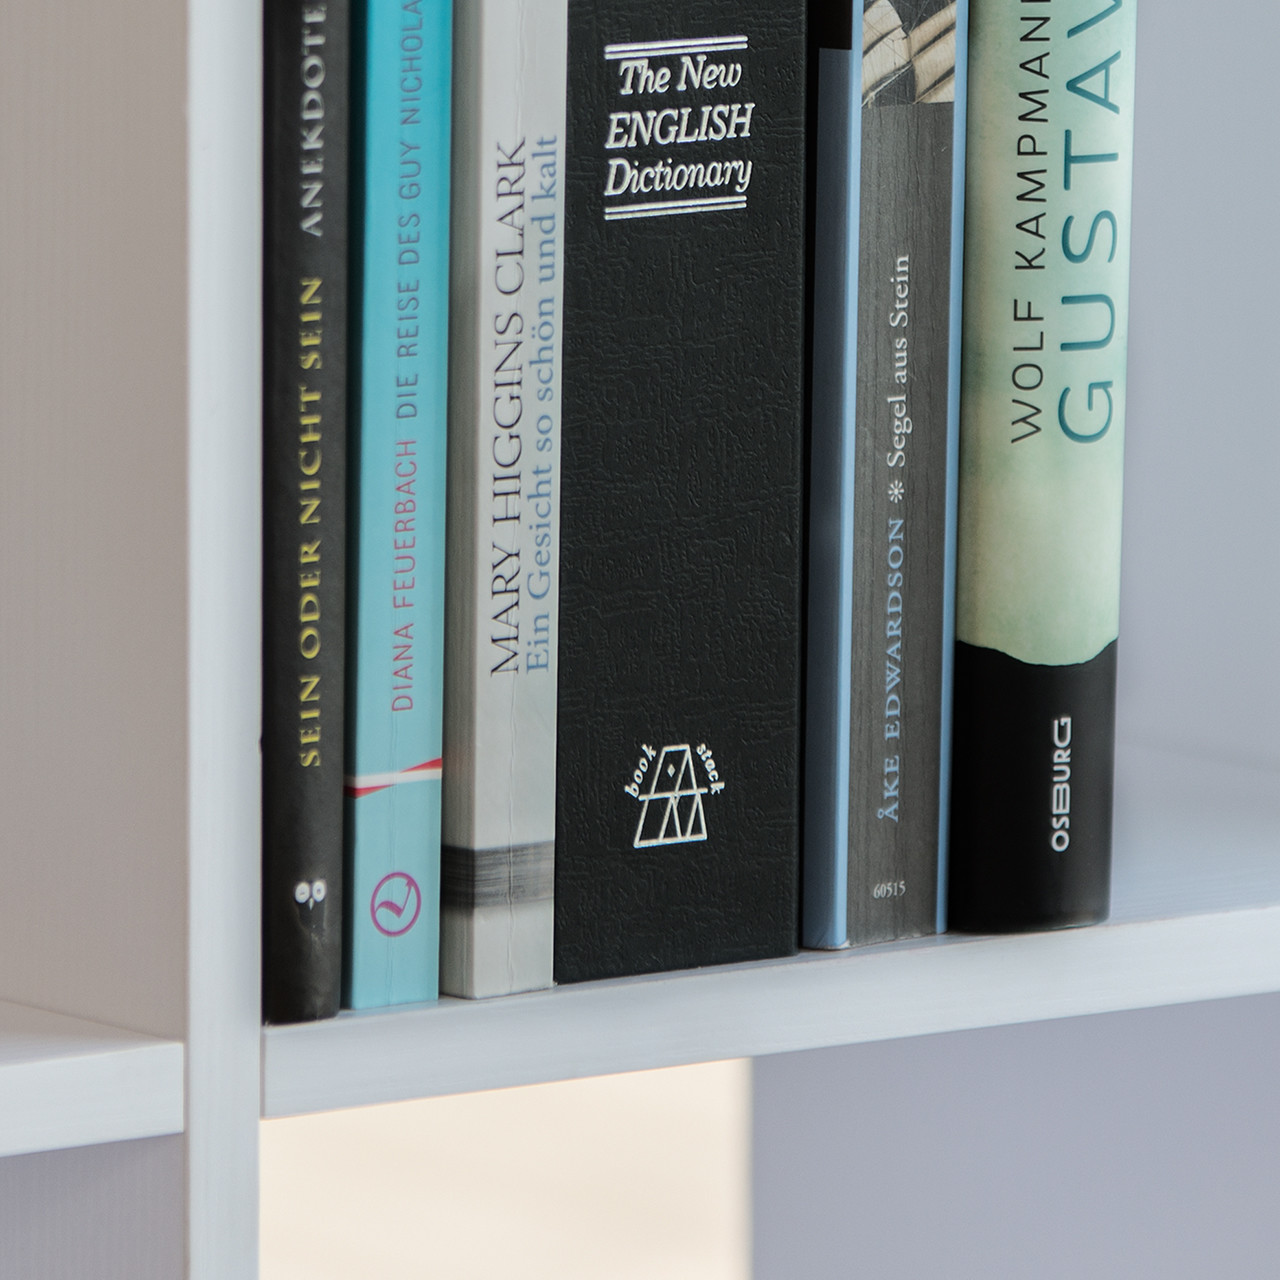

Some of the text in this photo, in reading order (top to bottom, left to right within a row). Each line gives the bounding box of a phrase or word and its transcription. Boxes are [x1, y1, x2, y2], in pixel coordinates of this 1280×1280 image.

[620, 53, 742, 95] The New
[400, 141, 421, 201] GUY
[604, 103, 755, 149] ENGLISH
[604, 157, 753, 196] Dictionary
[398, 211, 420, 266] DES
[300, 277, 323, 370] SEIN
[397, 279, 419, 358] REISE
[396, 373, 418, 420] DIE
[490, 136, 526, 676] MARY HIGGINS CLARK
[526, 135, 558, 674] Ein Gesicht so schön und kalt
[1010, 299, 1045, 444] WOLF
[300, 387, 322, 525] NICHT
[393, 439, 417, 609] FEUERBACH
[877, 254, 913, 823] ÅKE EDWARDSON Segel aus Stein
[300, 539, 321, 659] ODER
[391, 622, 413, 712] DIANA
[299, 675, 321, 768] SEIN
[624, 743, 725, 798] book stack
[1051, 716, 1072, 853] OSBURG
[873, 880, 906, 899] 60515
